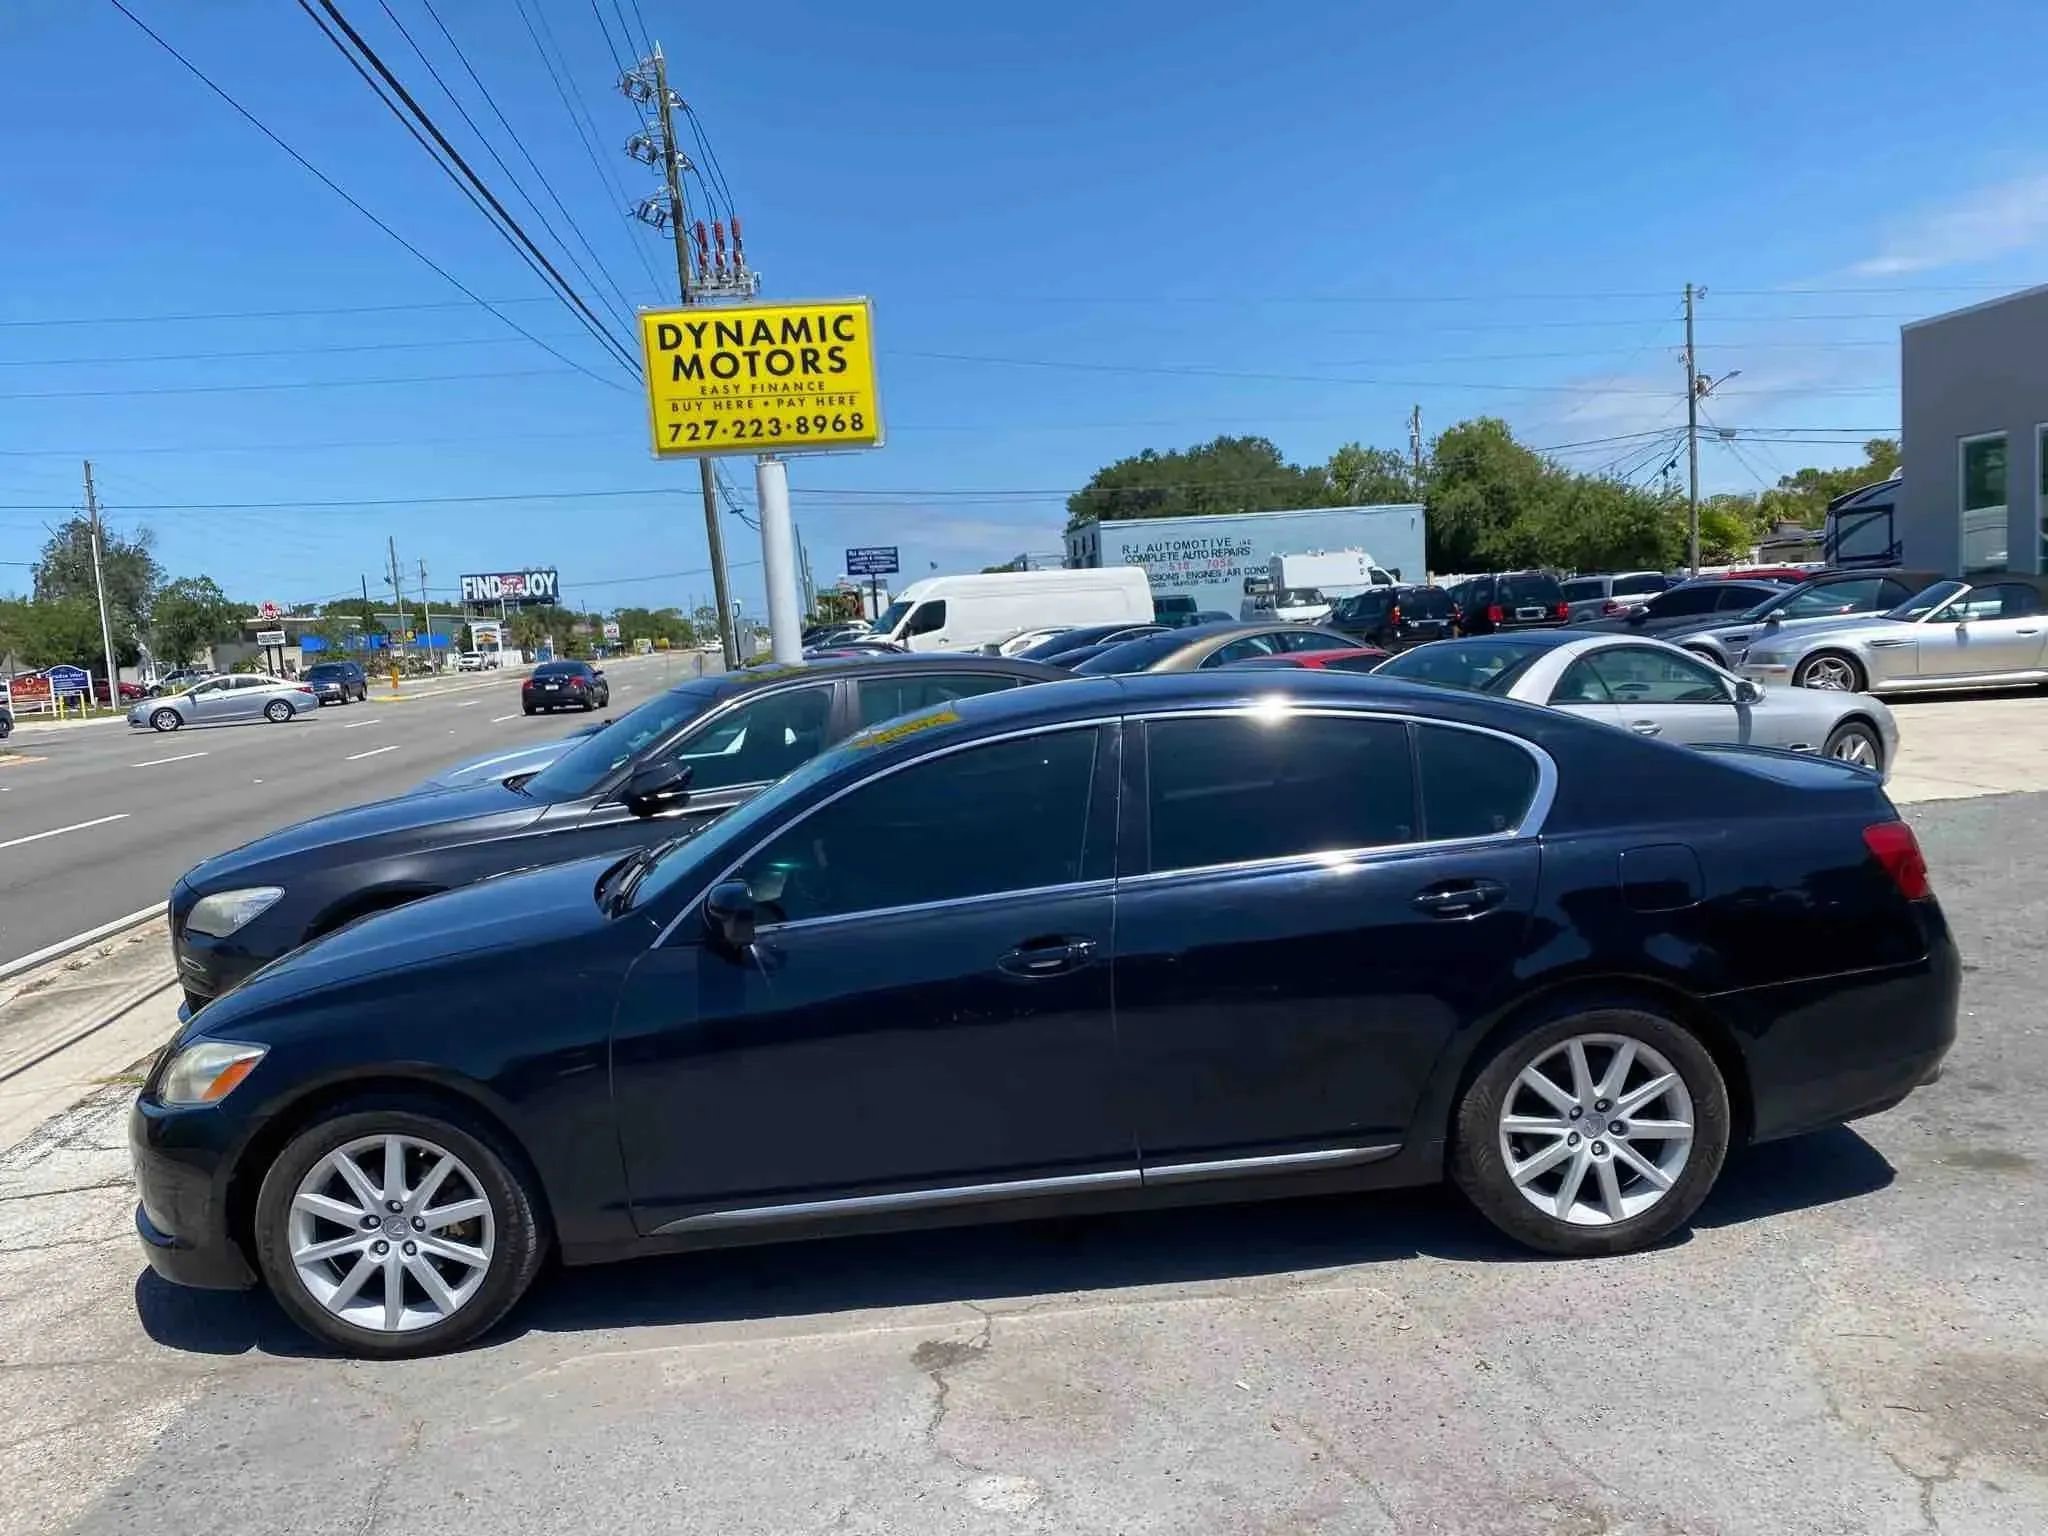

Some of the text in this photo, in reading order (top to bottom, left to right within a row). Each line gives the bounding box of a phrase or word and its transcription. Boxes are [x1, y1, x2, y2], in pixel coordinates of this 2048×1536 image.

[657, 314, 856, 350] DYNAMIC
[672, 346, 848, 382] MOTORS
[700, 381, 826, 396] EASY FINANCE
[671, 395, 857, 413] BUY HERE PAY HERE
[1146, 537, 1232, 553] AUTOMOTIVE
[1125, 546, 1251, 564] COMPLETE AUTO REPAIRS
[1186, 569, 1221, 580] ENGINES
[1226, 567, 1242, 577] AIR
[461, 575, 502, 600] FIND
[522, 572, 555, 597] JOY
